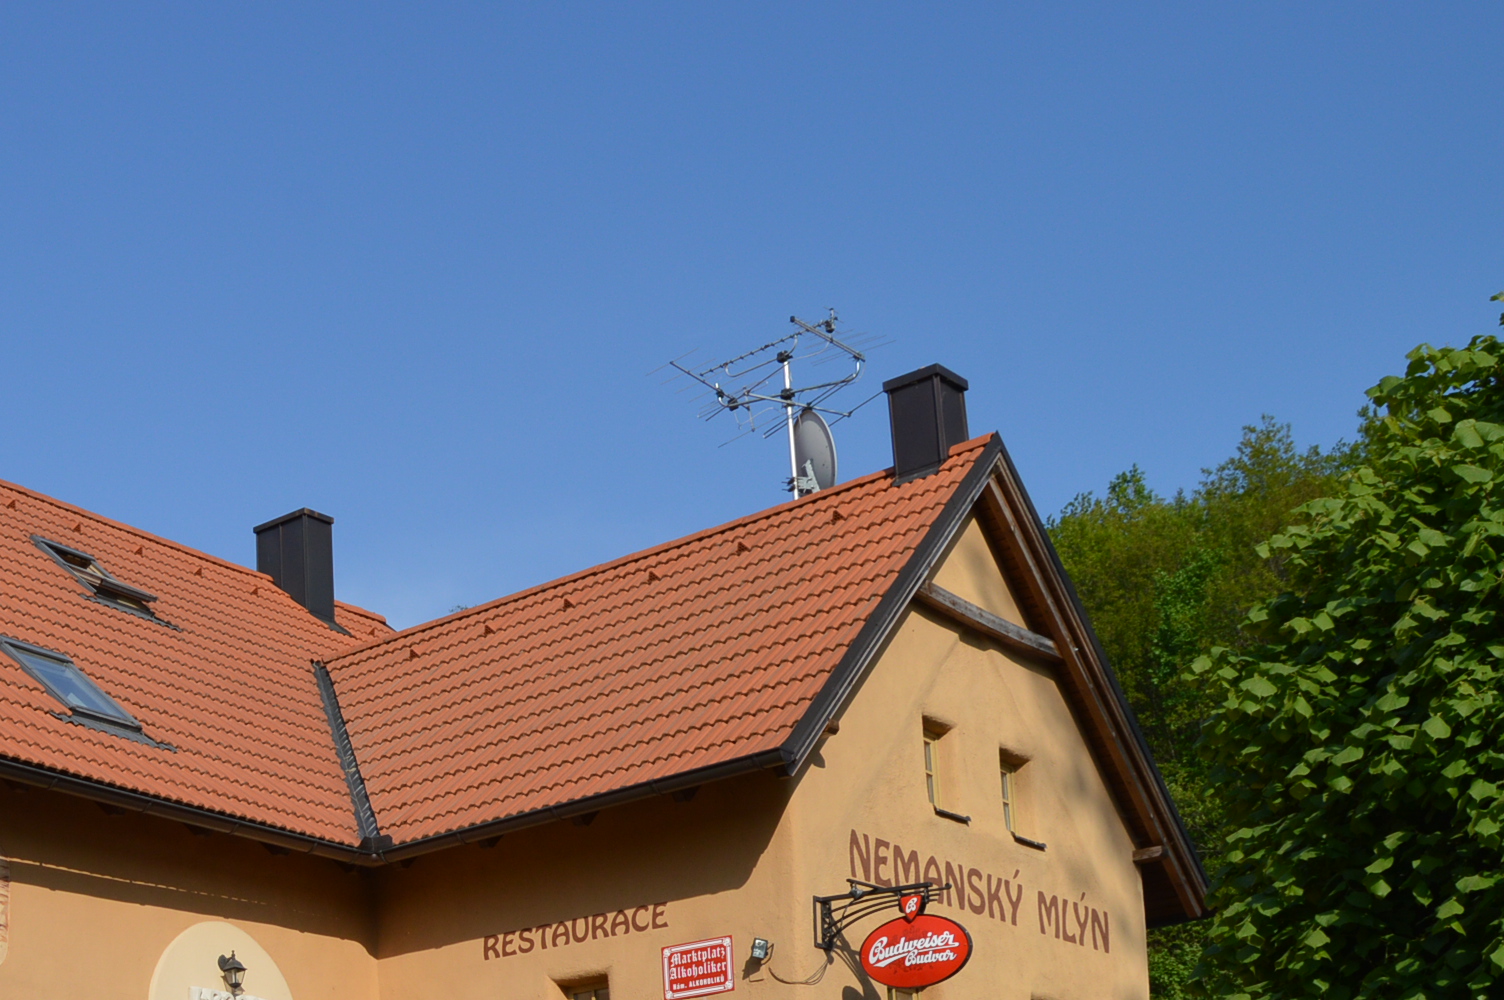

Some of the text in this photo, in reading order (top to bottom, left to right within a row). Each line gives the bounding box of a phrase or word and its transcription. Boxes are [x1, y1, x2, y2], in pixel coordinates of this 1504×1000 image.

[849, 829, 1110, 953] NEMANSKÝ MLÝN
[483, 902, 669, 961] RESTAURACE
[670, 946, 726, 967] Marktplatz
[868, 931, 959, 965] Budweiser
[904, 949, 957, 966] Budvar
[669, 961, 727, 980] Alkoholiker
